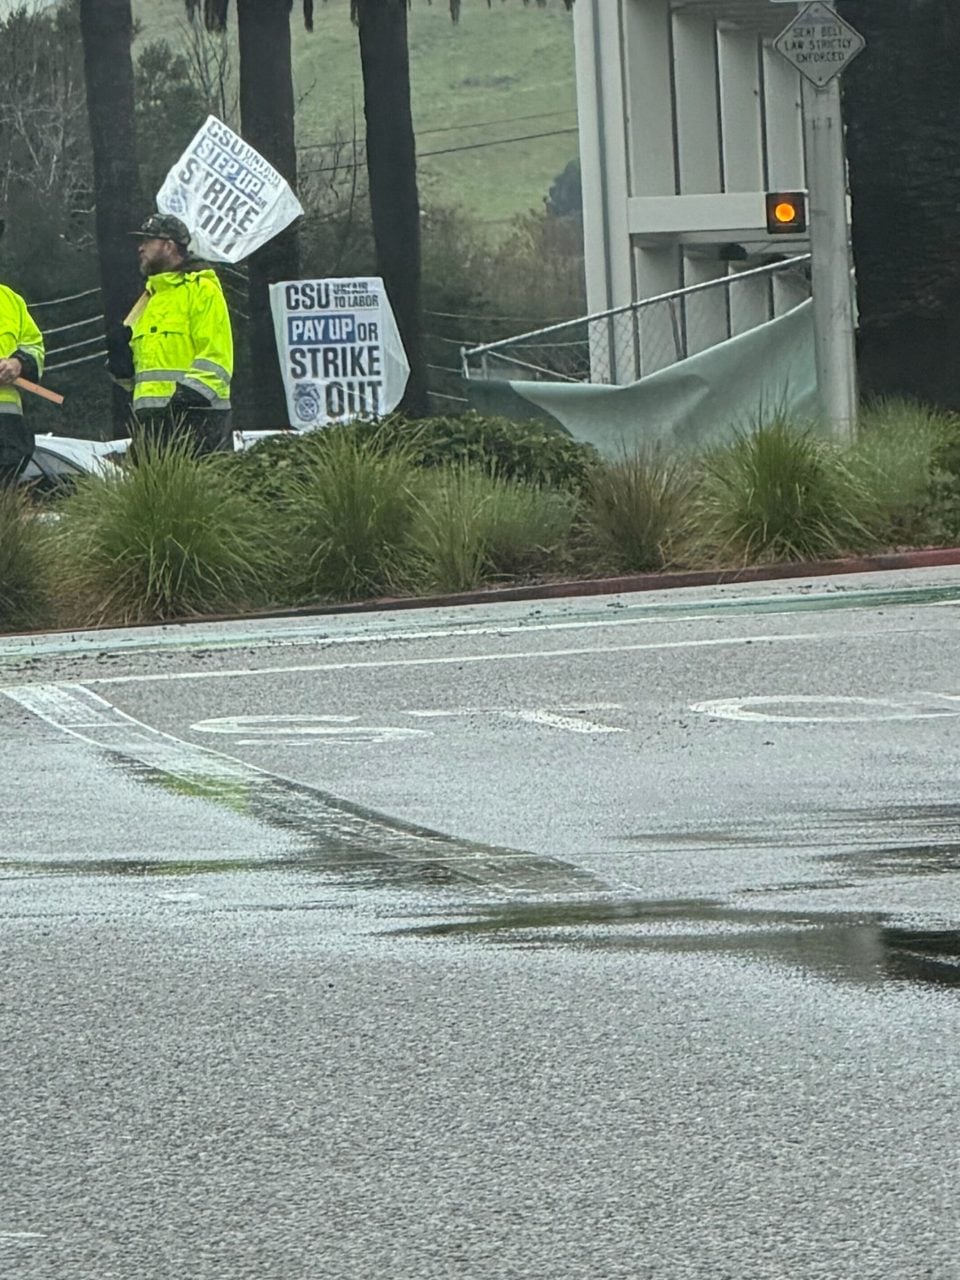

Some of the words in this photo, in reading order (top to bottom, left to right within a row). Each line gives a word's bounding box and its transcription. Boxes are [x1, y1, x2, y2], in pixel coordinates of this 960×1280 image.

[784, 39, 803, 51] LAW
[810, 38, 852, 50] STRICTLY
[793, 27, 816, 38] SEAT
[821, 26, 844, 37] BELT
[796, 52, 844, 63] ENFORCED
[207, 120, 246, 156] CSU
[195, 140, 240, 177] STEP
[239, 164, 263, 195] UP
[178, 156, 260, 233] STRIKE
[197, 204, 242, 254] OUT
[285, 283, 330, 310] CSU
[334, 295, 346, 308] TO
[348, 295, 379, 308] LABOR
[292, 320, 326, 342] PAY
[329, 318, 353, 341] UP
[357, 323, 378, 342] OR
[290, 345, 381, 379] STRIKE
[325, 380, 382, 419] OUT
[190, 691, 960, 745] STO
